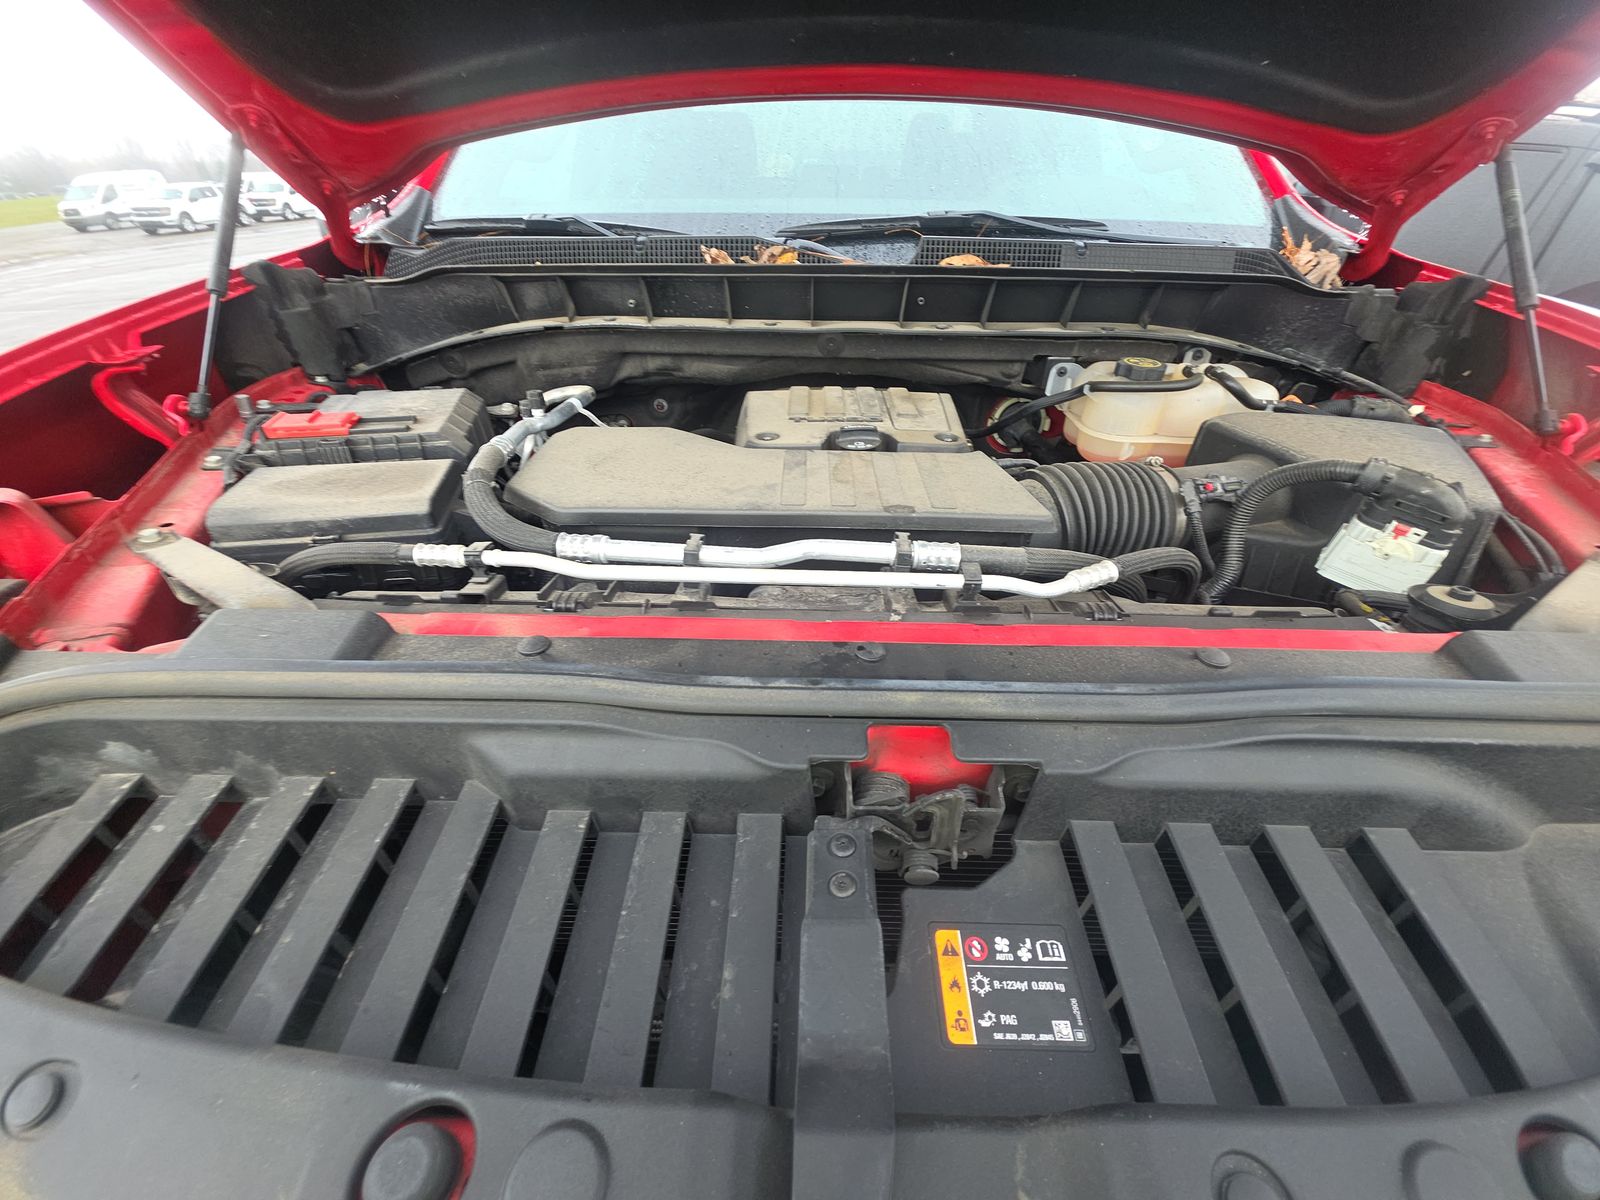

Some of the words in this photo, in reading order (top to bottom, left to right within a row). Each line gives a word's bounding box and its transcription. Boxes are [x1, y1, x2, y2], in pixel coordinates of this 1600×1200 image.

[995, 953, 1014, 961] AUTO
[993, 980, 1028, 991] R-1234yf
[1054, 981, 1066, 992] kg
[999, 1014, 1018, 1025] PAG
